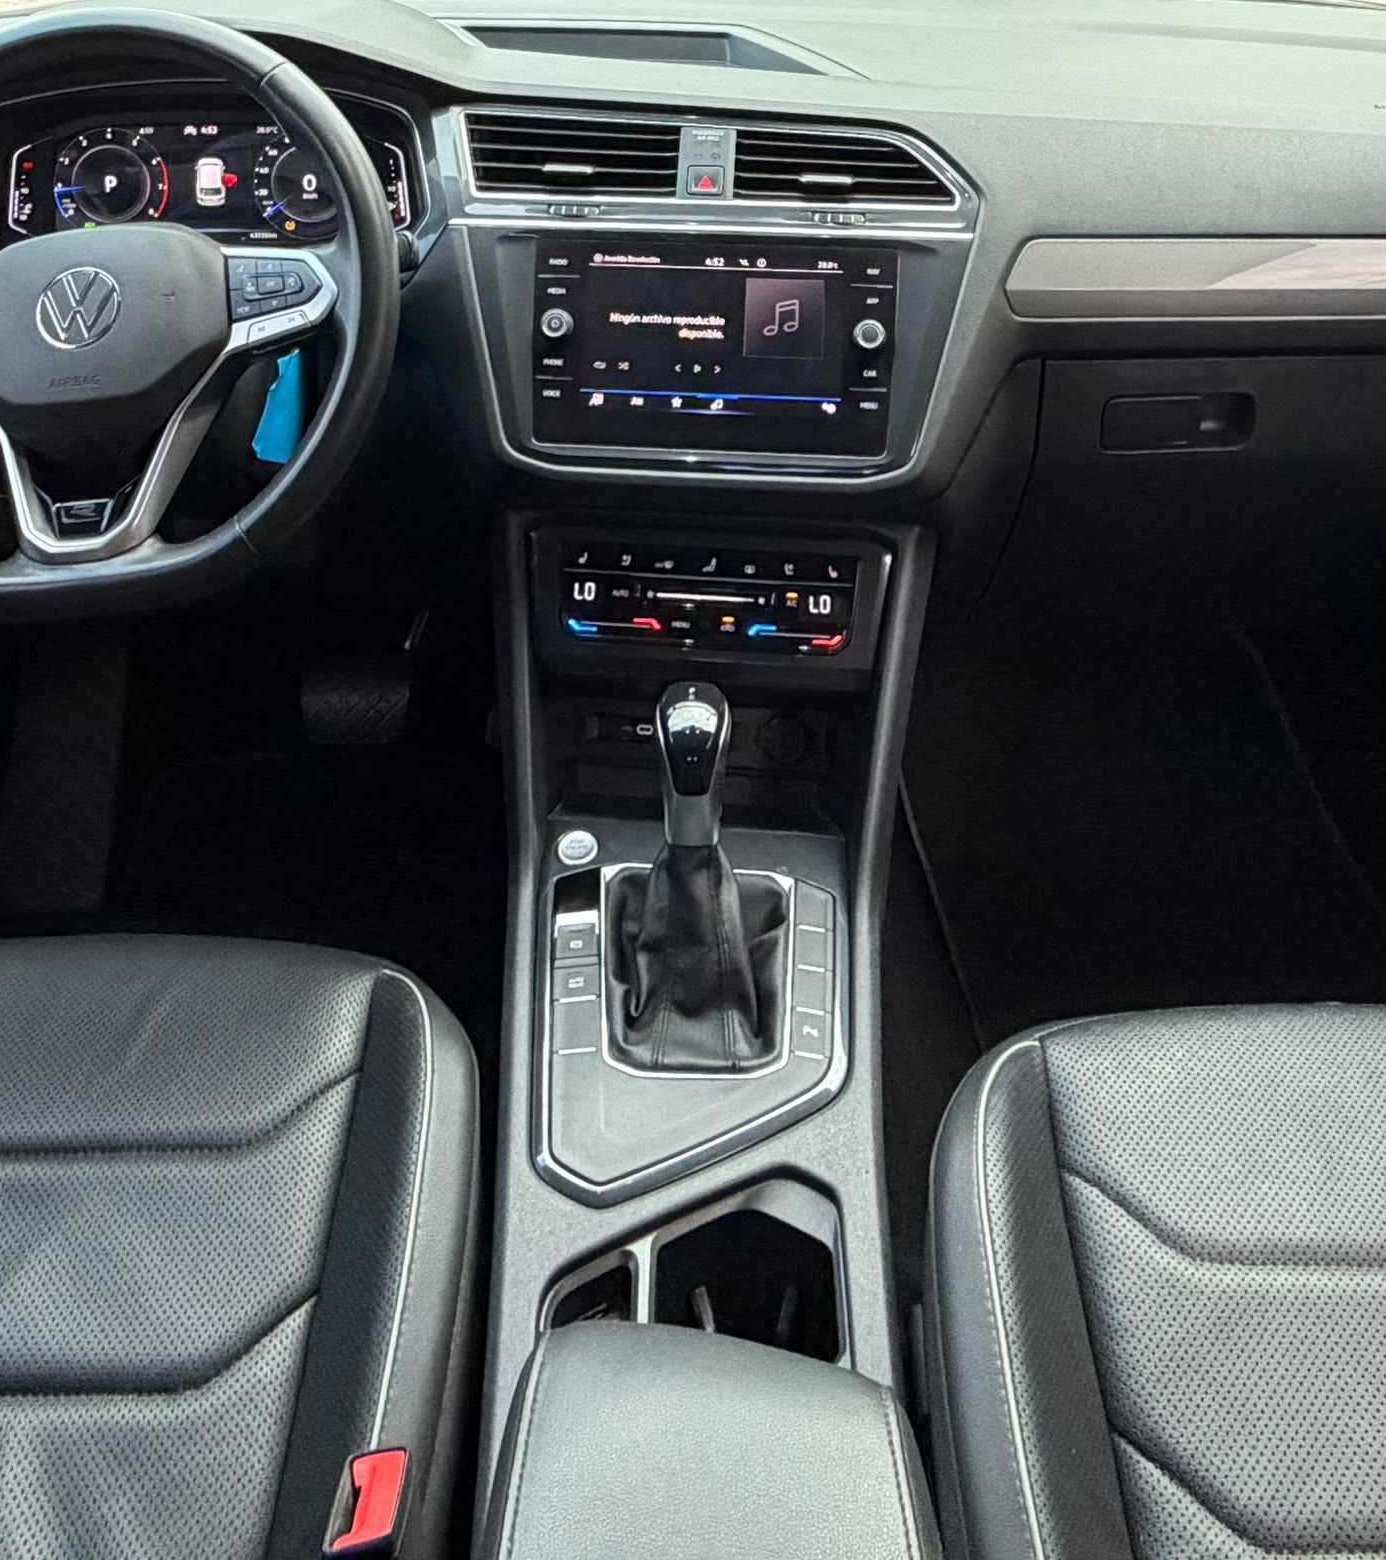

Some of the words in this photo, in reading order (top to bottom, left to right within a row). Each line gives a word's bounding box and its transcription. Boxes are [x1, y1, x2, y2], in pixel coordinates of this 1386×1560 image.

[104, 175, 118, 193] P
[302, 173, 317, 192] 0
[609, 312, 641, 325] Ningún
[641, 313, 673, 324] archivo
[673, 315, 725, 326] reproducible
[47, 374, 101, 389] AIRBAG
[573, 581, 596, 601] LO
[809, 594, 831, 614] LO
